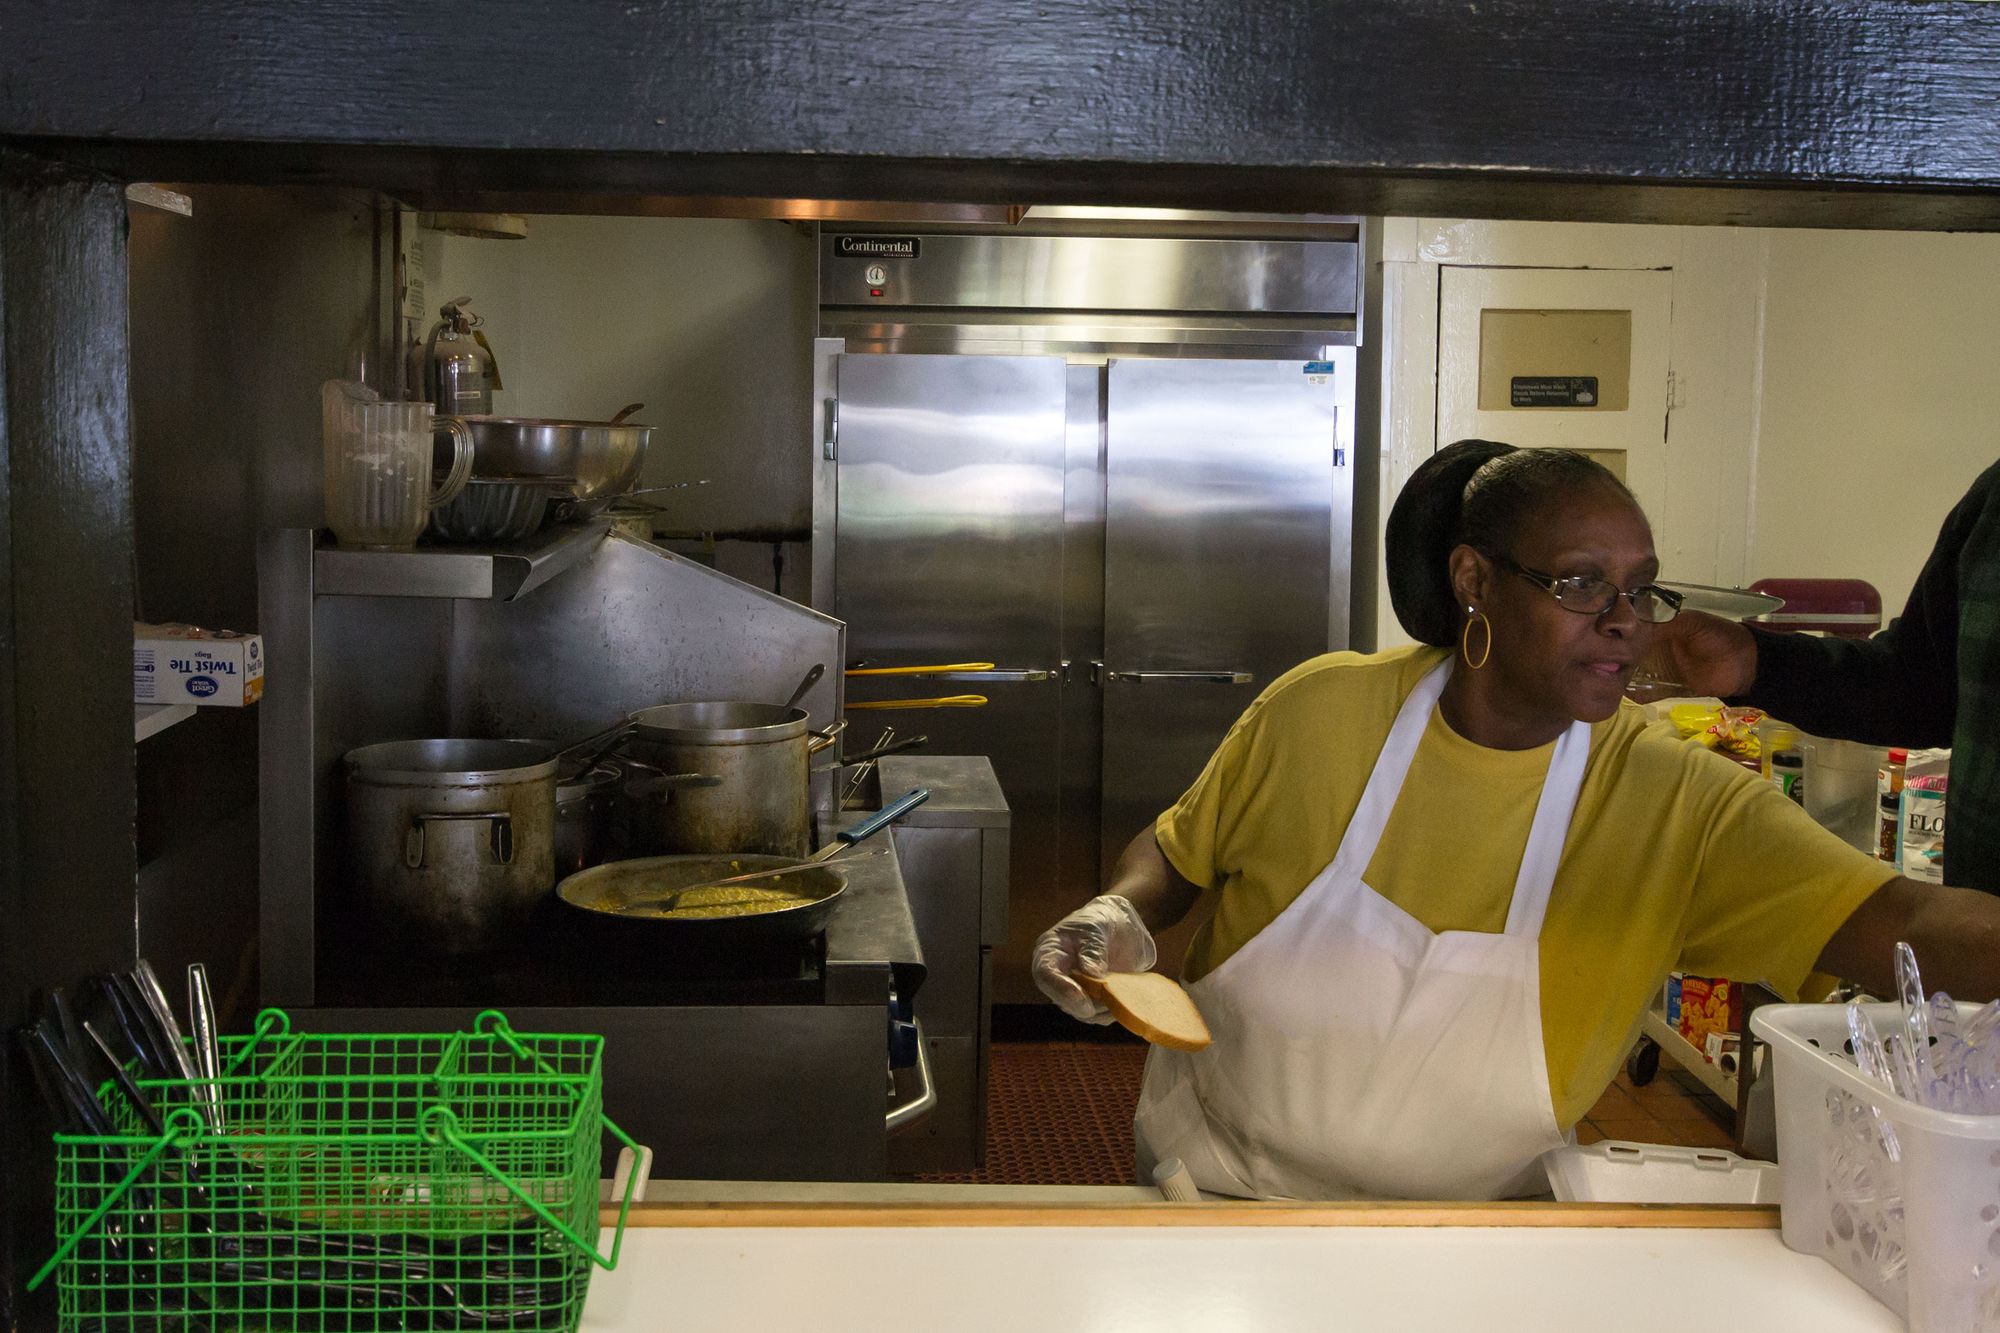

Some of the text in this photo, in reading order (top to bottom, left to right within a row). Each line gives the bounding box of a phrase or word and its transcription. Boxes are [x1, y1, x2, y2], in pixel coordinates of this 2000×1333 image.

[842, 237, 914, 252] Continental
[194, 651, 212, 659] Bags
[170, 659, 236, 674] Twist Tie
[192, 685, 215, 693] Great
[1910, 814, 1945, 832] FLO
